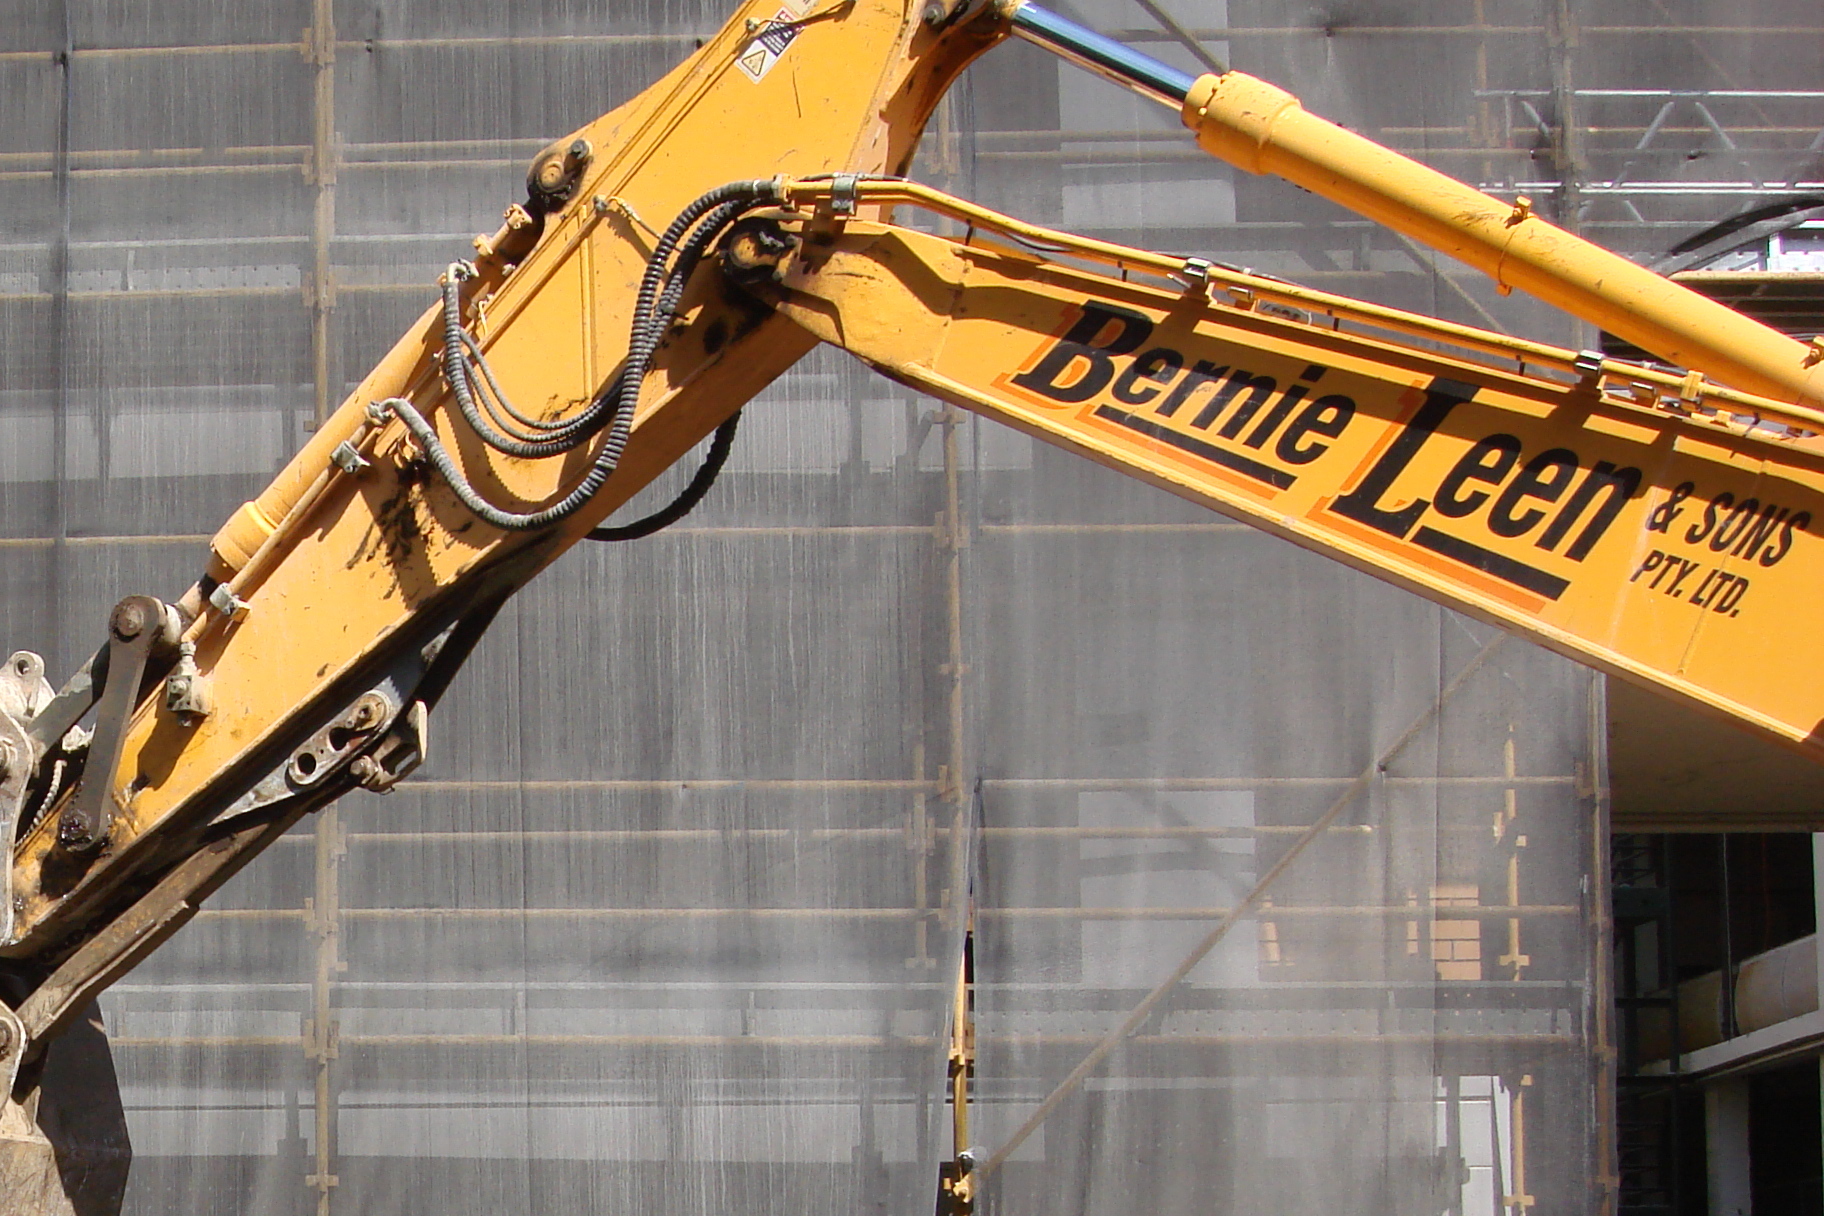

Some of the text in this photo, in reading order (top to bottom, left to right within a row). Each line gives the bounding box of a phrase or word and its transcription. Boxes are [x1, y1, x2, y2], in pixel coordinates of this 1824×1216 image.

[1009, 299, 1812, 568] Bernie Leen & SONS
[1629, 549, 1750, 619] PTY. LTD.
